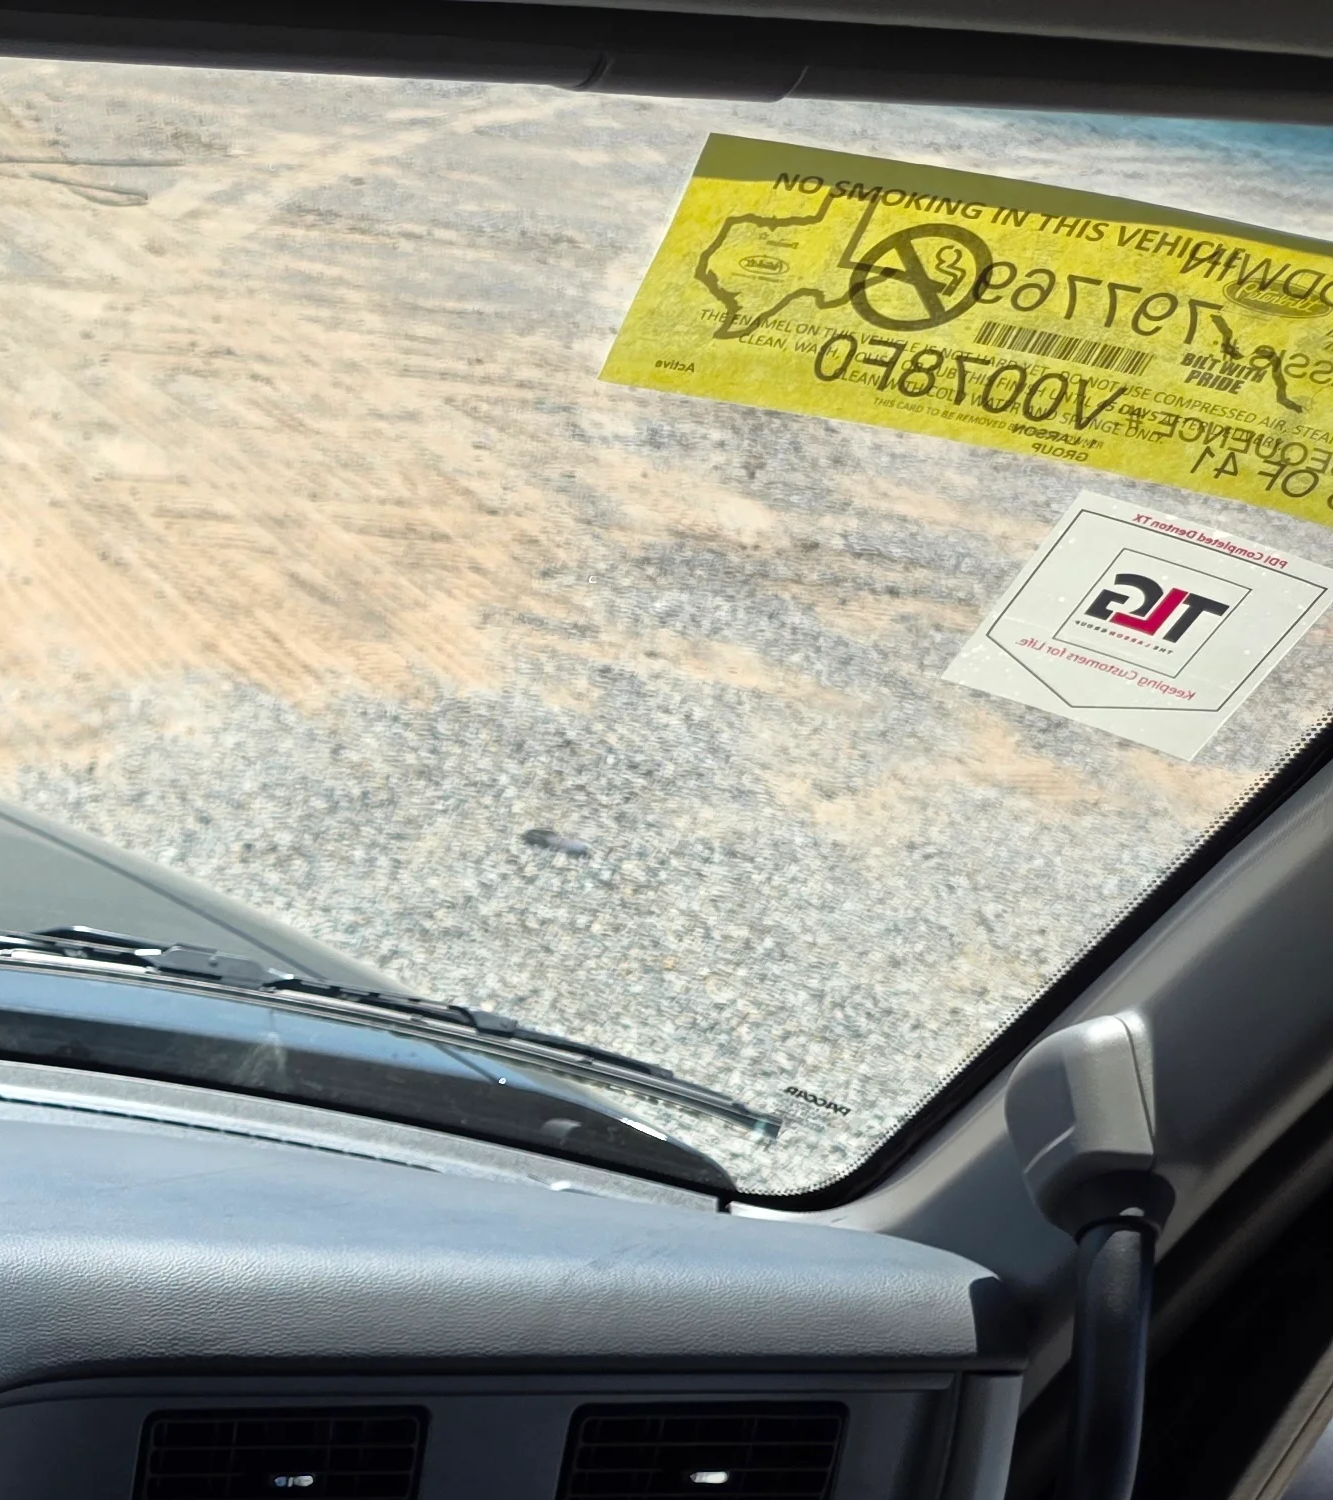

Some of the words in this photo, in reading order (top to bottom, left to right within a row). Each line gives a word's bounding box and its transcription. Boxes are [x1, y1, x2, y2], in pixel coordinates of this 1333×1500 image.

[773, 172, 823, 195] NO
[829, 179, 985, 220] SMOKING
[990, 205, 1030, 228] IN
[1037, 213, 1109, 243] THIS
[1116, 225, 1248, 269] VEHICLE
[738, 332, 788, 352] CLEAN,
[700, 309, 729, 323] THE
[730, 314, 792, 333] ENAMEL
[795, 324, 822, 336] ON
[1153, 391, 1257, 424] COMPRESSED
[1260, 416, 1288, 434] AIR,
[1183, 371, 1246, 396] PRIDE
[1220, 359, 1268, 384] WITH
[896, 402, 924, 414] CARD
[955, 412, 1005, 431] REMOVED
